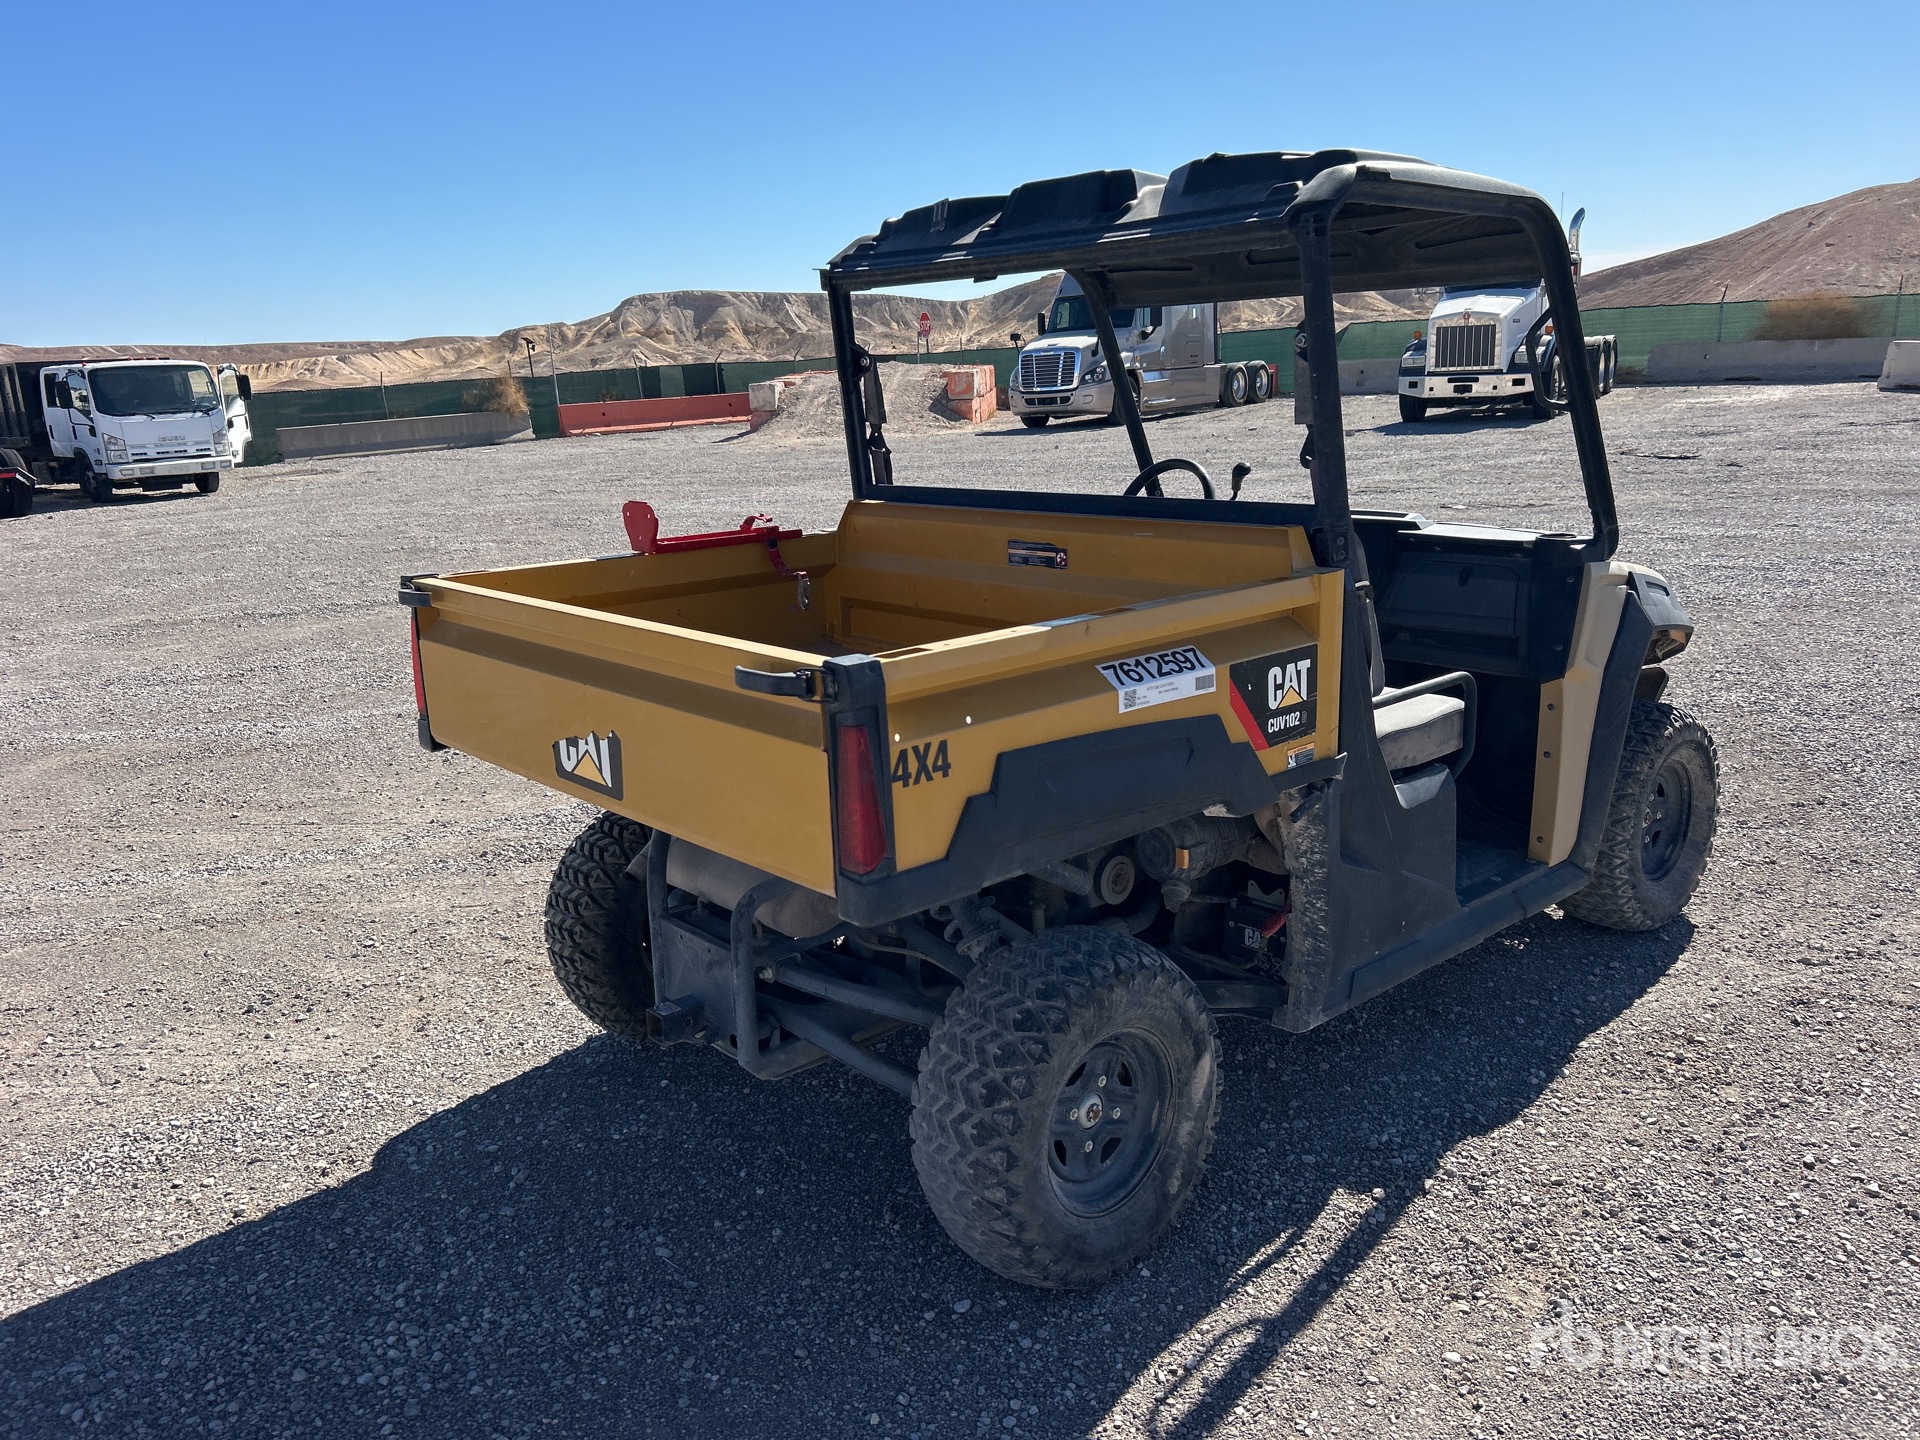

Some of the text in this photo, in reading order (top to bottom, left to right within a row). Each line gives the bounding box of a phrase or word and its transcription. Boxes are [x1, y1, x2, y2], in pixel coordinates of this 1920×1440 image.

[920, 321, 930, 330] STOP
[1101, 647, 1205, 685] 7612597
[1268, 659, 1311, 710] CAT
[1268, 711, 1300, 733] CUV102
[892, 739, 951, 788] 4X4
[1244, 928, 1261, 948] CA
